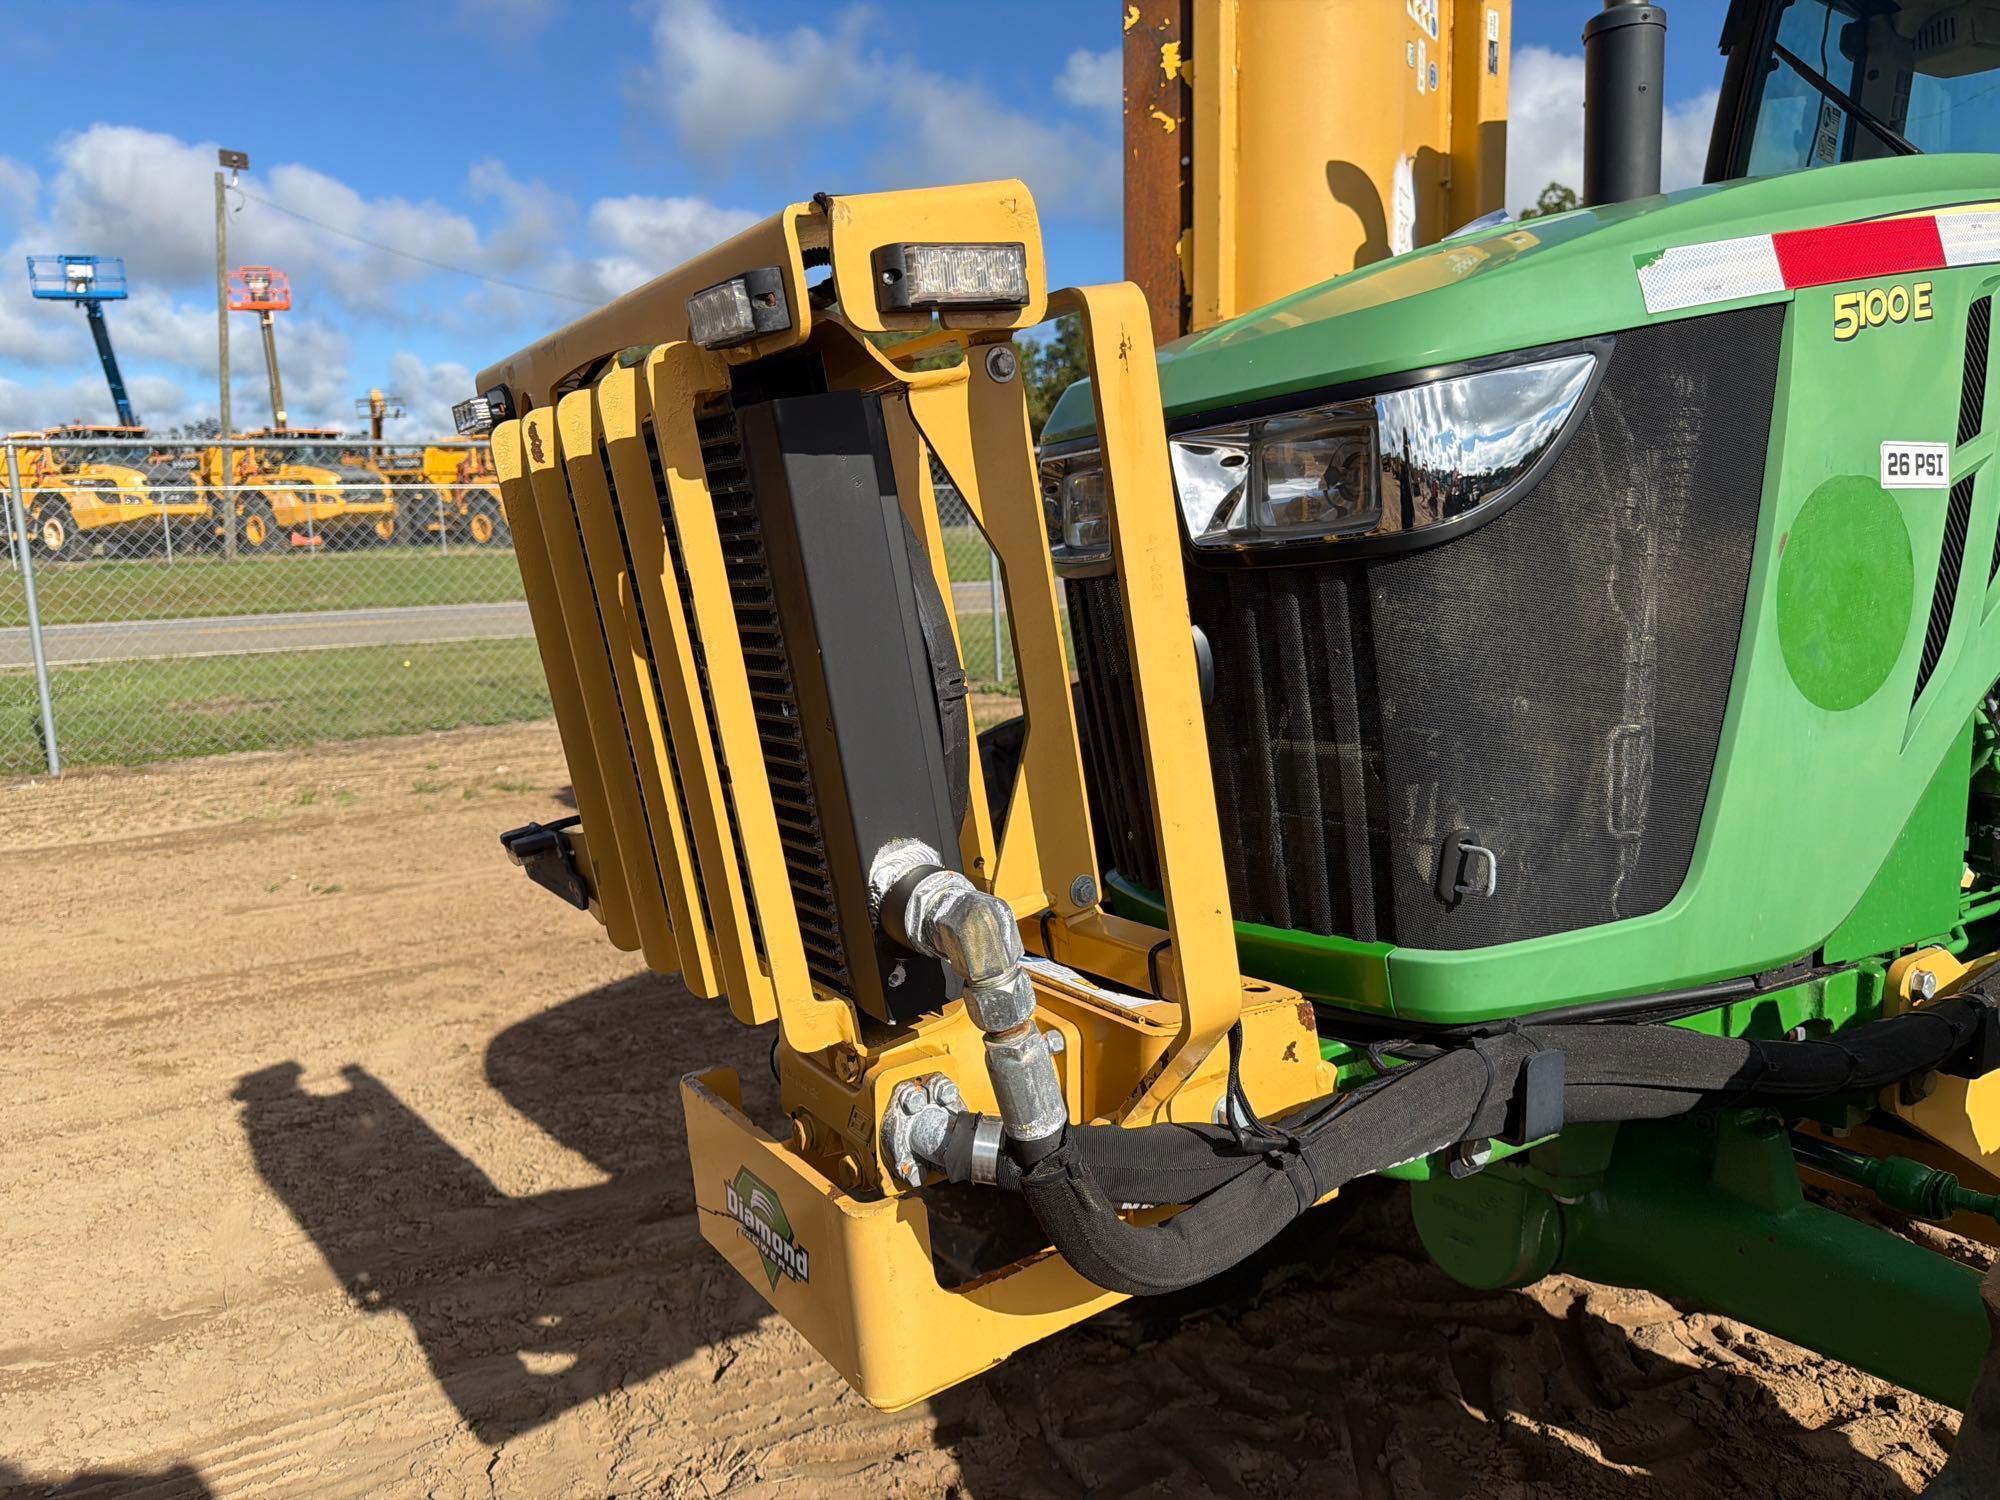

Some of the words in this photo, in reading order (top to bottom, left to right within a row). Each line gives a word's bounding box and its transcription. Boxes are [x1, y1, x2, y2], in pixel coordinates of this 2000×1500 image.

[1888, 452, 1911, 476] 26
[1915, 453, 1944, 476] PSI
[726, 1185, 808, 1280] Diamond
